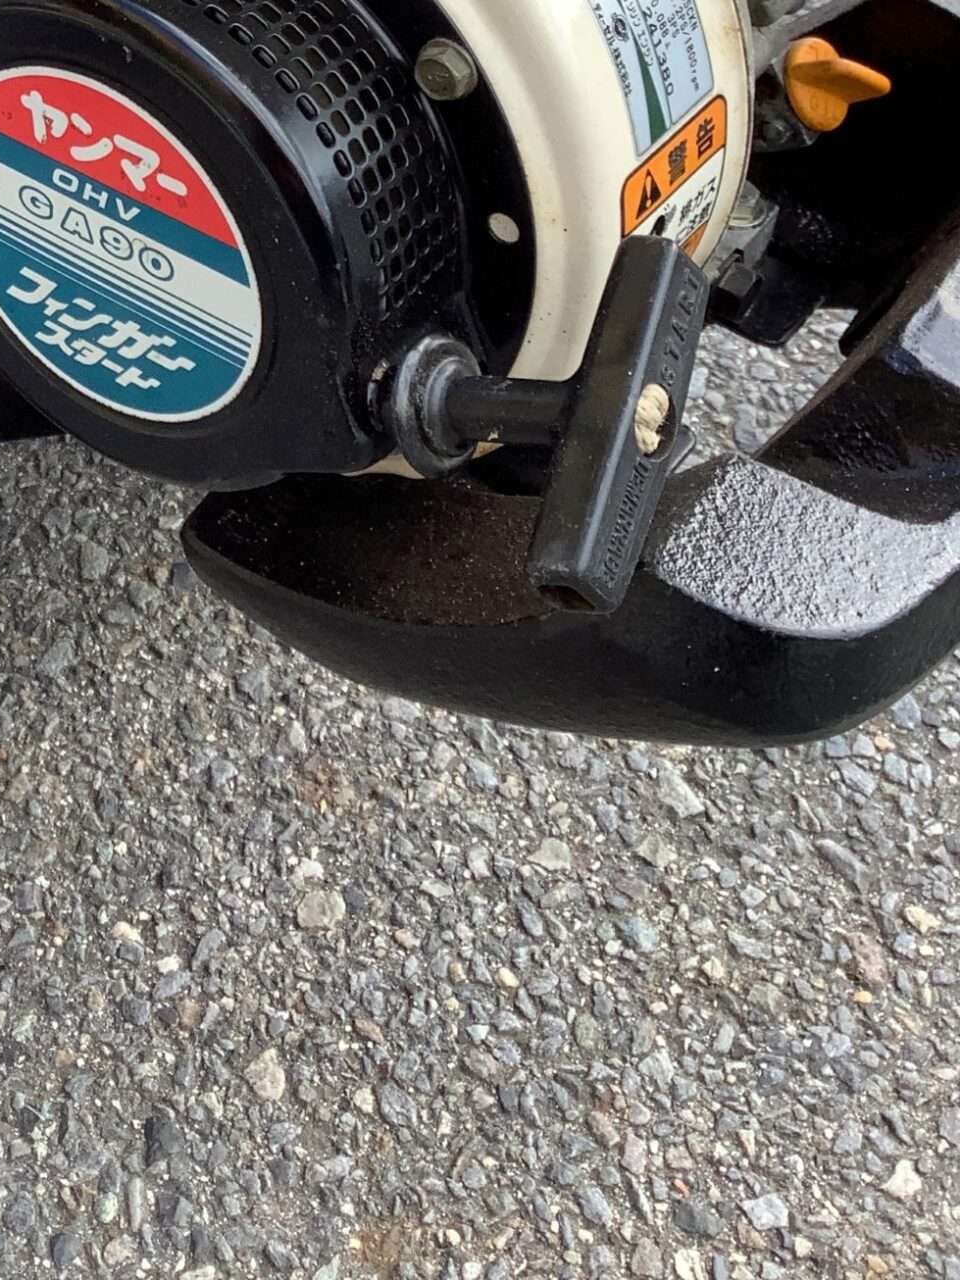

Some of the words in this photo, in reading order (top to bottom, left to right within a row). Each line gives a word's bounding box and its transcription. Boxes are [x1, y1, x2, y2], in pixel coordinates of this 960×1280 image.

[20, 90, 188, 197] ヤンマー
[18, 185, 175, 282] GA90
[52, 168, 141, 222] OHV
[5, 266, 197, 371] フィンガー
[34, 320, 161, 389] スタート
